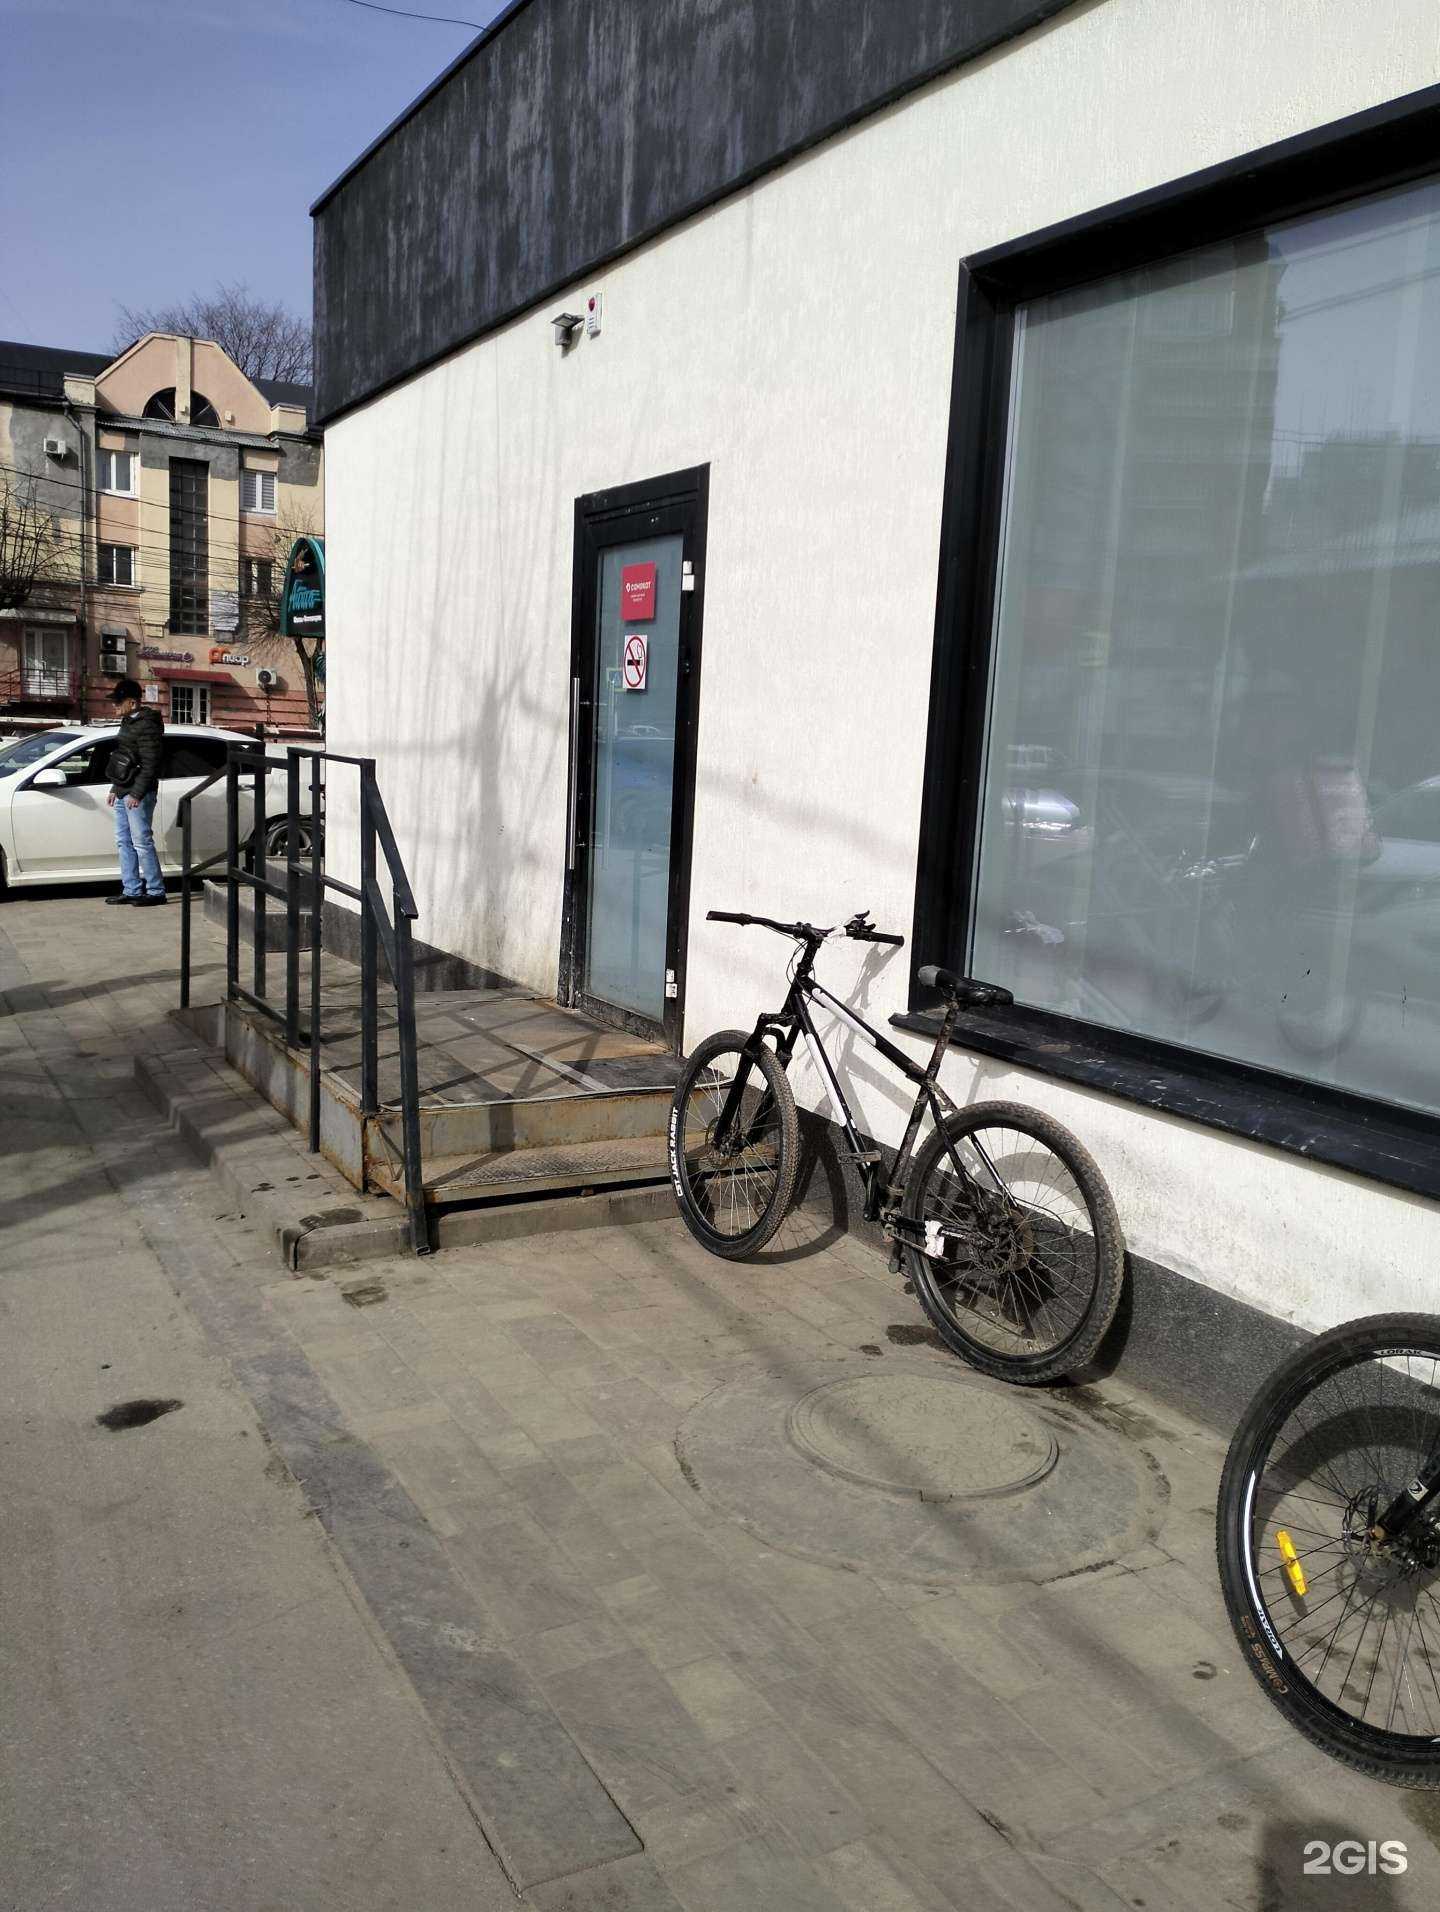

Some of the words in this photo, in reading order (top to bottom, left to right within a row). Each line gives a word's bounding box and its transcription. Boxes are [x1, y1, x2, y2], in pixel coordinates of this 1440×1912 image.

[670, 1107, 678, 1147] RABBIT
[670, 1149, 679, 1178] JACK
[674, 1180, 684, 1197] CST
